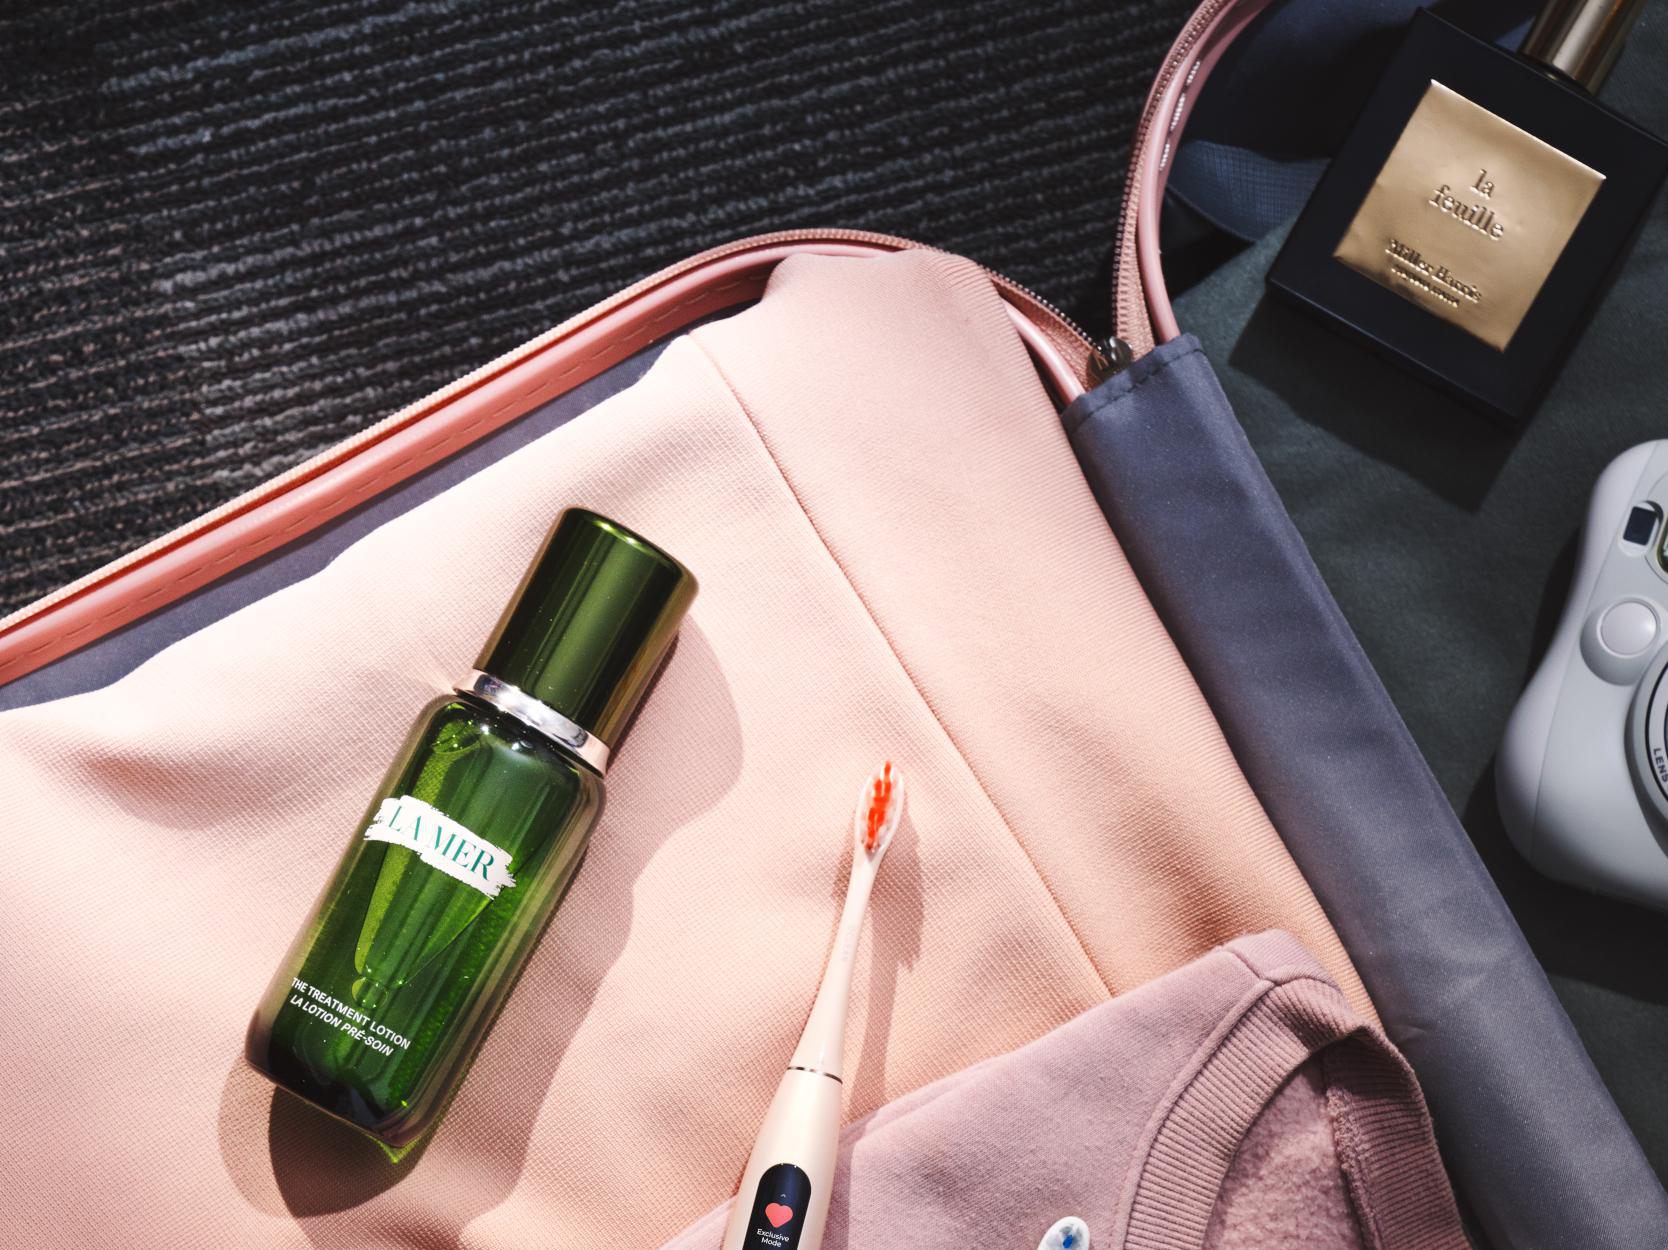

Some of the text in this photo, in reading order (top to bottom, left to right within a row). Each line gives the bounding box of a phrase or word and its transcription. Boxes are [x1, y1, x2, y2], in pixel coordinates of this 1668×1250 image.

[1469, 168, 1496, 200] la
[1429, 184, 1505, 241] feuille
[1653, 747, 1668, 783] LENS
[388, 805, 496, 881] LA MER
[290, 994, 394, 1057] LA LOTION PRÉ-SOIN
[291, 977, 412, 1050] THE TREATMENT LOTION
[756, 1228, 789, 1242] Exclusive
[761, 1237, 782, 1248] Mode
